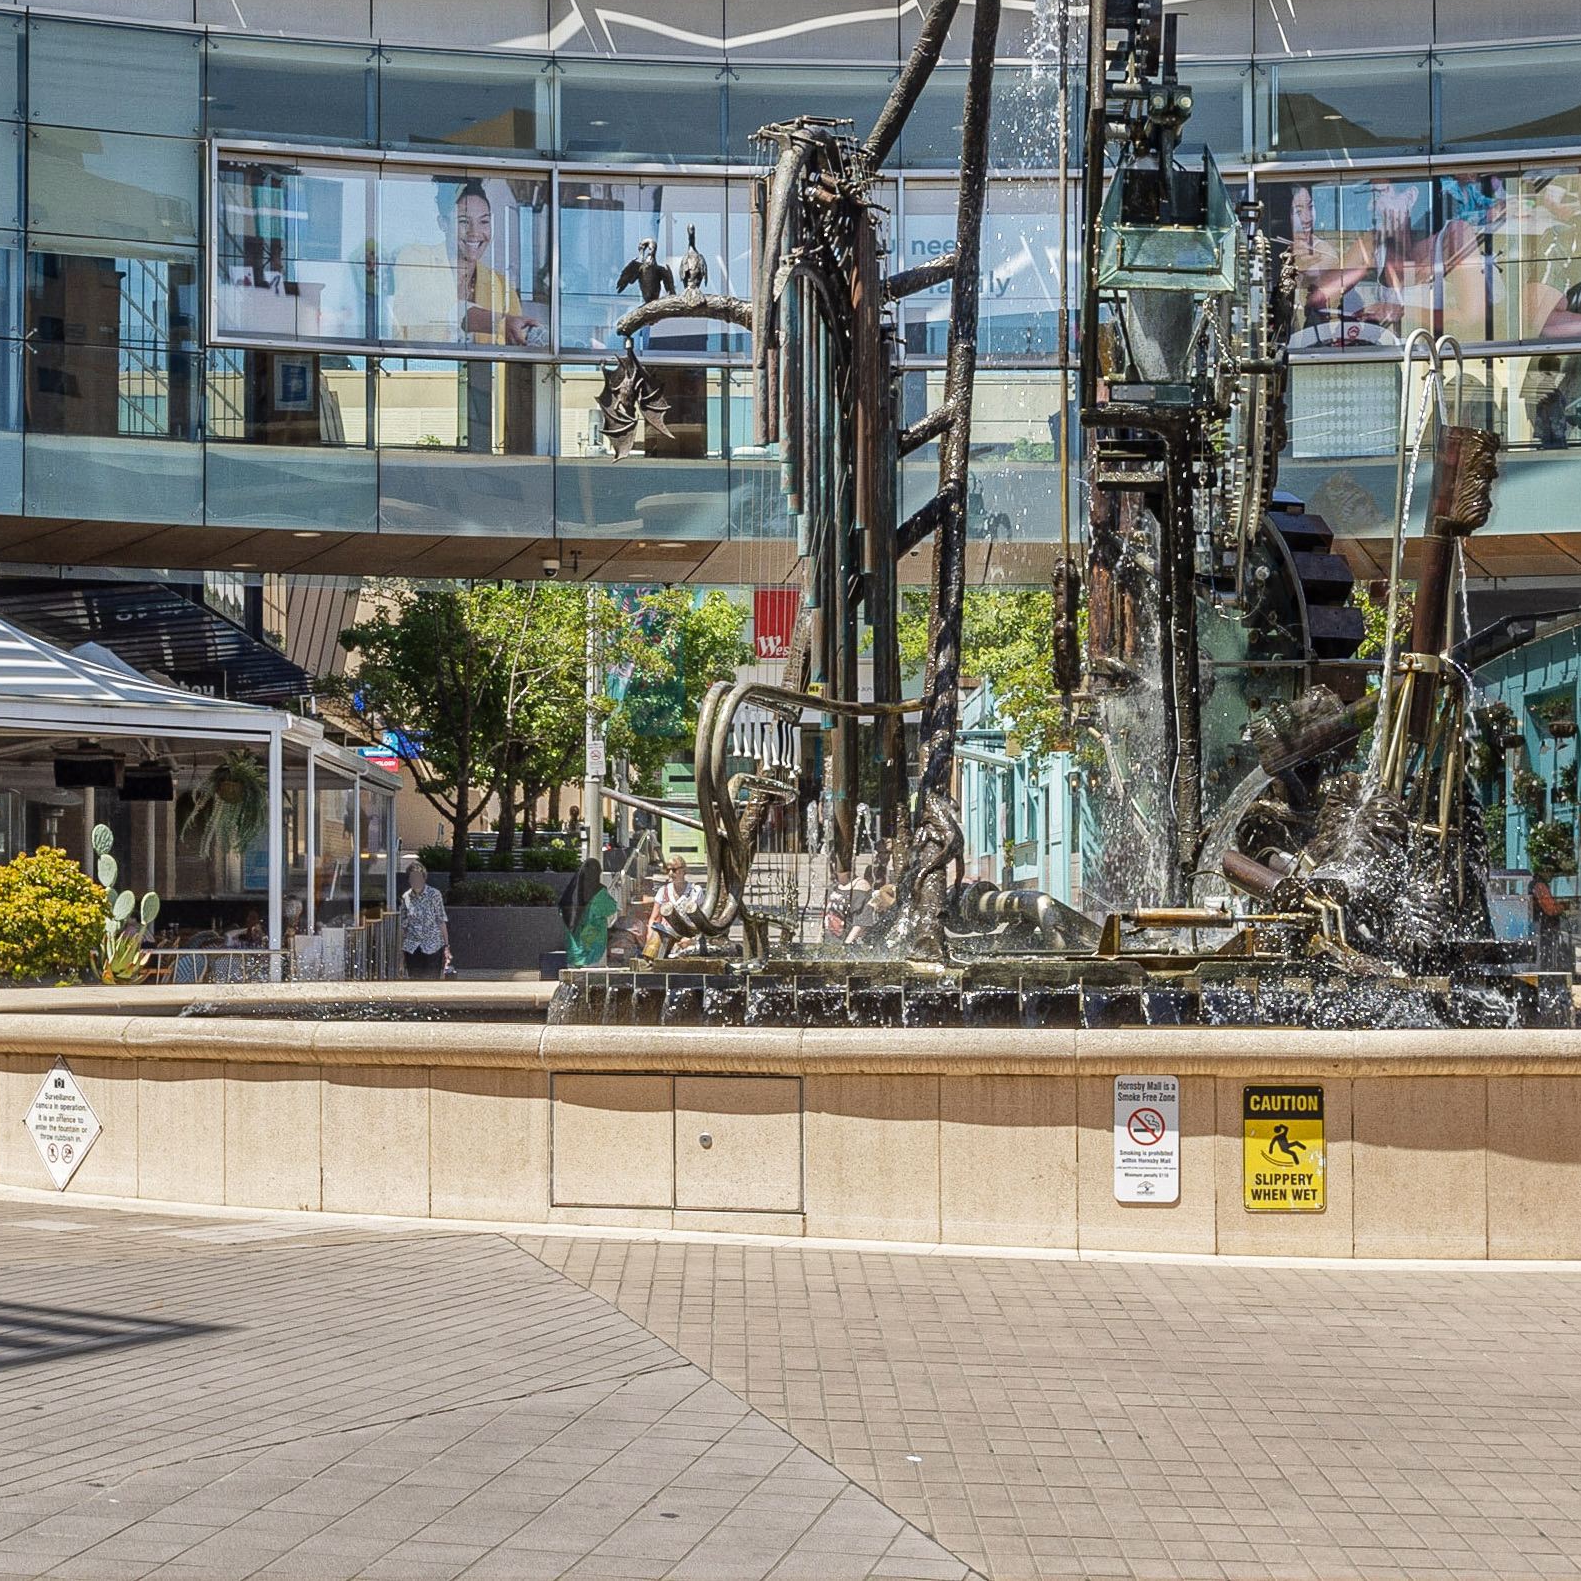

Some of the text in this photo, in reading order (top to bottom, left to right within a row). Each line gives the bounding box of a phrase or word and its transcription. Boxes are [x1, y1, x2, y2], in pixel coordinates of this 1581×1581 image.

[911, 240, 958, 256] nee
[757, 635, 790, 657] Wes
[1118, 1081, 1145, 1092] Hornsby
[1147, 1082, 1162, 1090] Mall
[1163, 1081, 1170, 1090] is
[1118, 1092, 1176, 1102] Smoke Free Zone
[1250, 1095, 1318, 1111] CAUTION
[1255, 1174, 1313, 1187] SLIPPERY
[1251, 1189, 1318, 1201] WHEN WET
